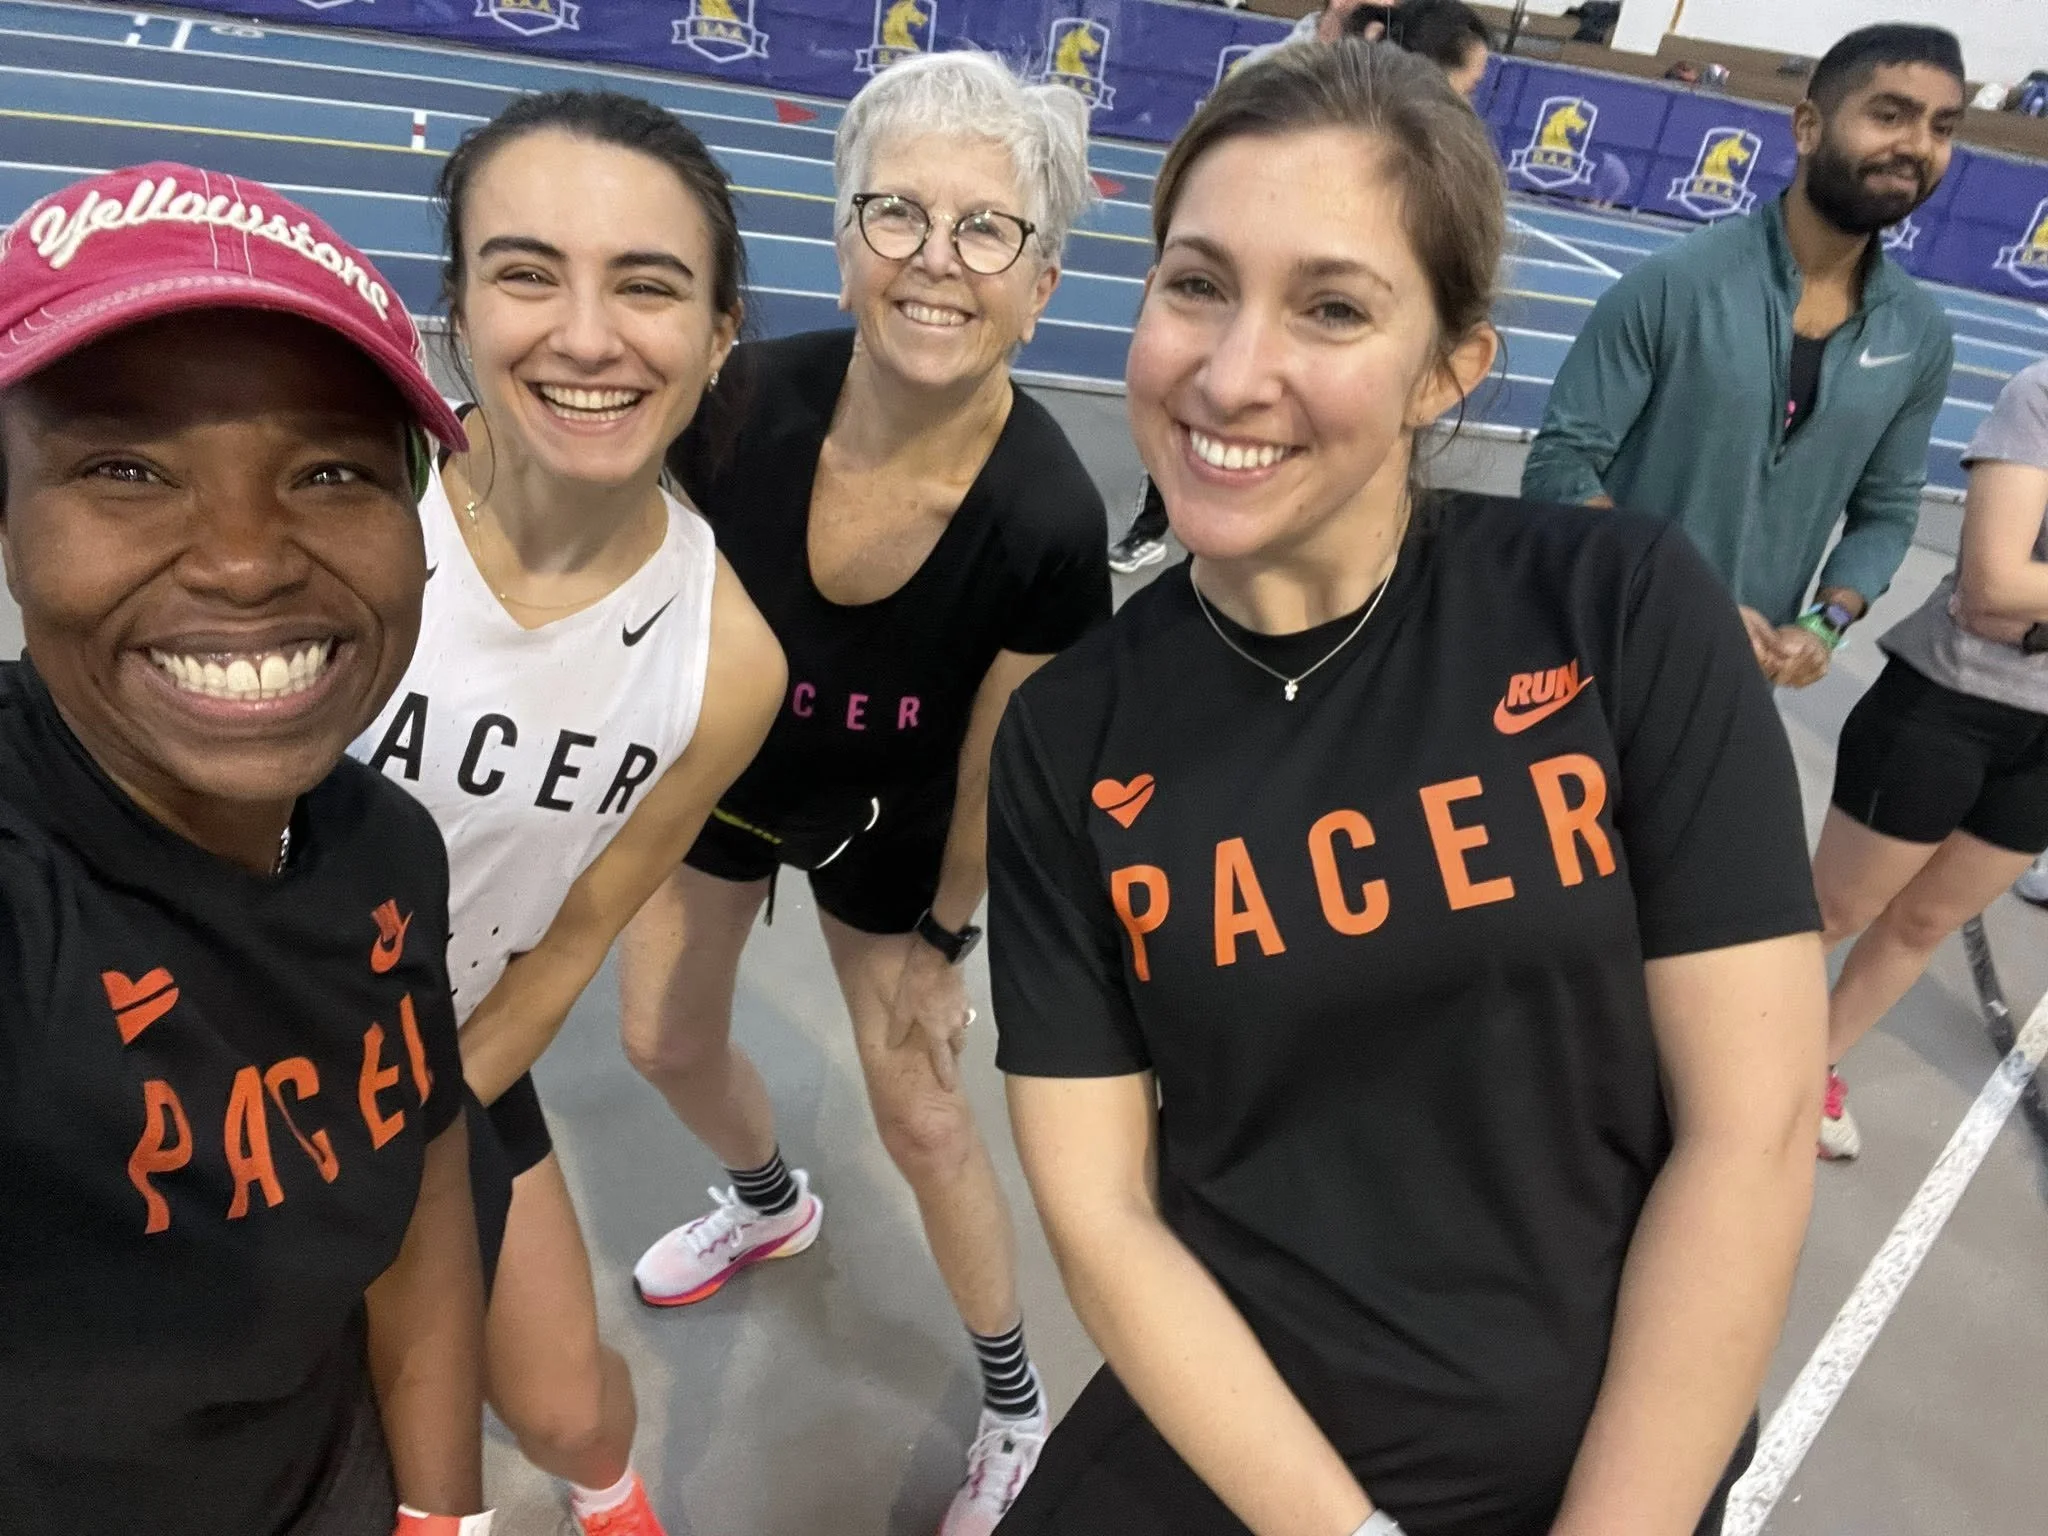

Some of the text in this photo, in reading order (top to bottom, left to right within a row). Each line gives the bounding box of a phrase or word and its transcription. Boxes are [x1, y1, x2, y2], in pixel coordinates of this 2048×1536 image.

[30, 176, 390, 322] Yellowstone
[792, 682, 921, 731] CER
[1506, 658, 1580, 707] RUN
[368, 691, 658, 815] ACER
[1110, 752, 1616, 982] PACER
